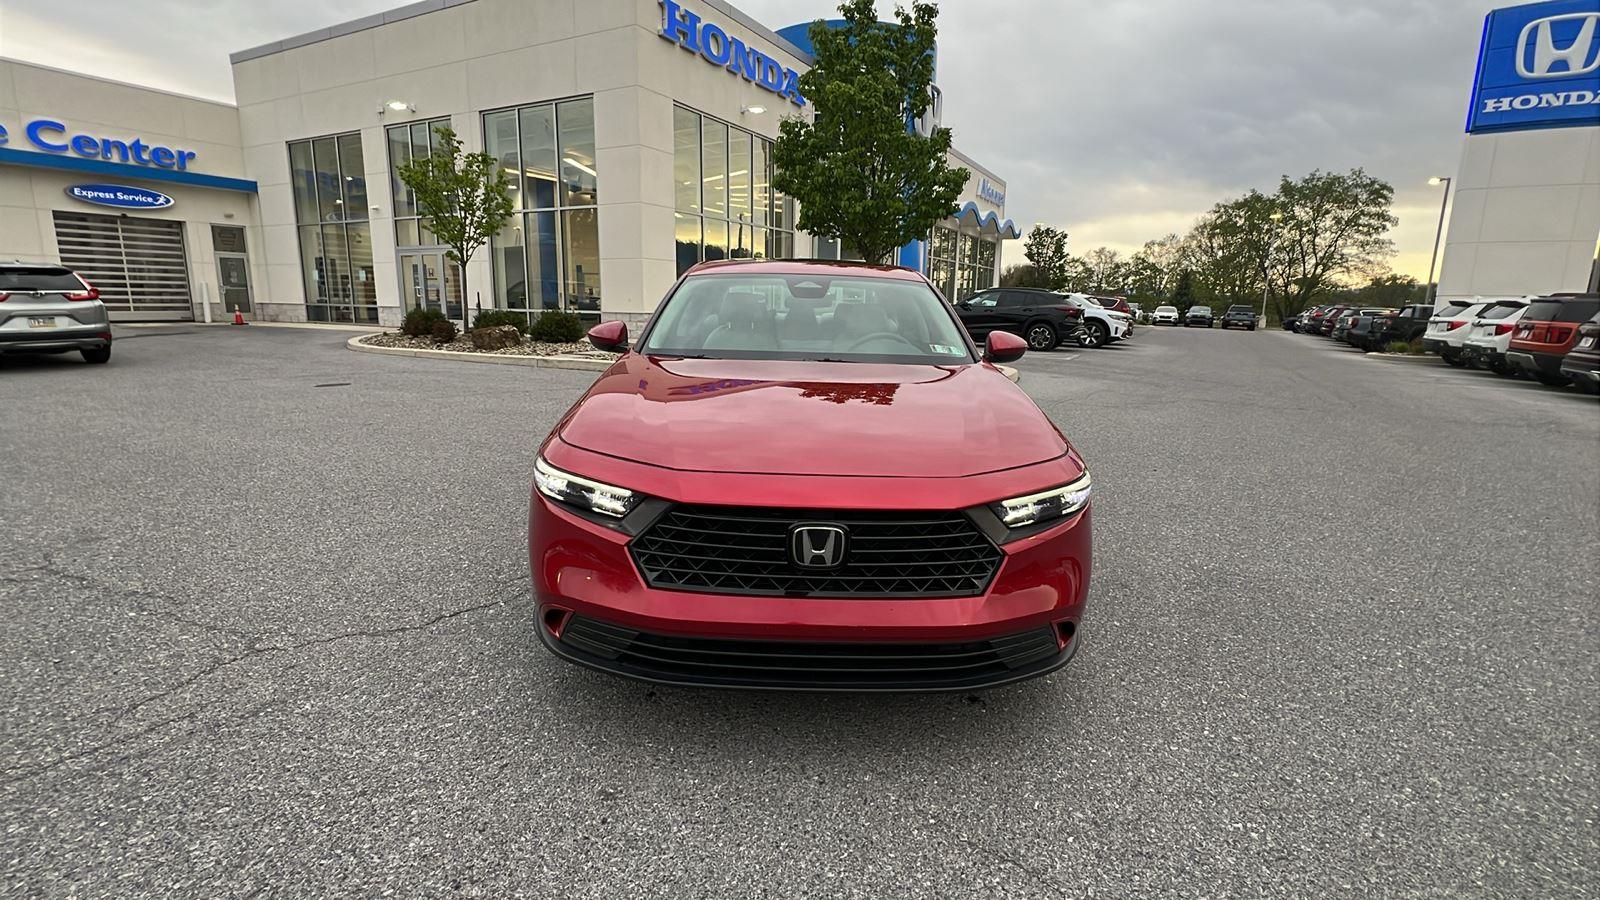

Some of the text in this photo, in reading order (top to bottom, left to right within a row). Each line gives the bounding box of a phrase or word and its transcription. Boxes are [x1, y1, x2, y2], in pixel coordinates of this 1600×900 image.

[660, 0, 806, 106] HONDA
[26, 120, 196, 170] Center
[73, 187, 153, 203] Express Service
